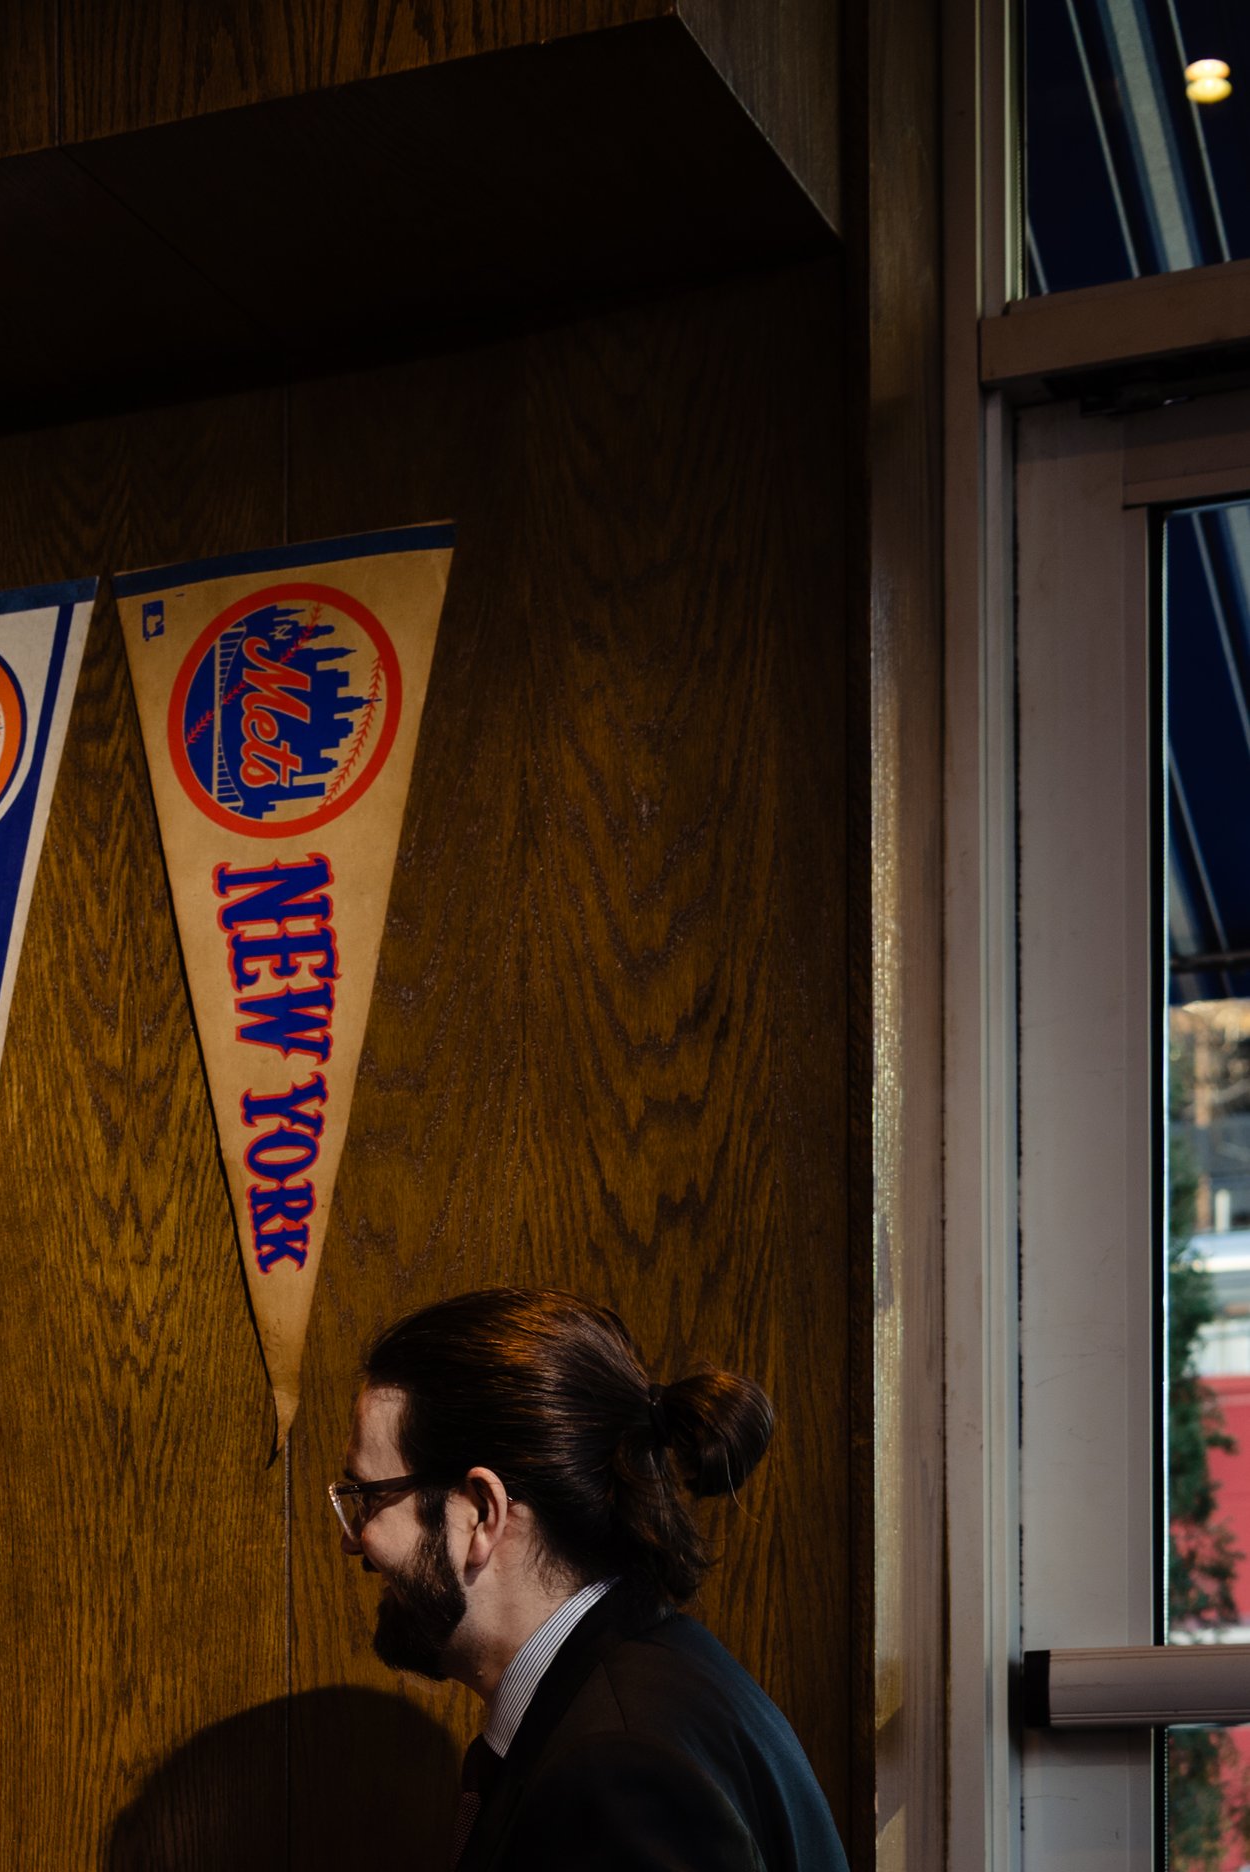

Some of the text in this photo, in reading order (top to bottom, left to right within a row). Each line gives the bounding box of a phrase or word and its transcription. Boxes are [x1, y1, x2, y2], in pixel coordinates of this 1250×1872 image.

[240, 637, 311, 788] Mets
[212, 852, 343, 1275] NEW YORK
